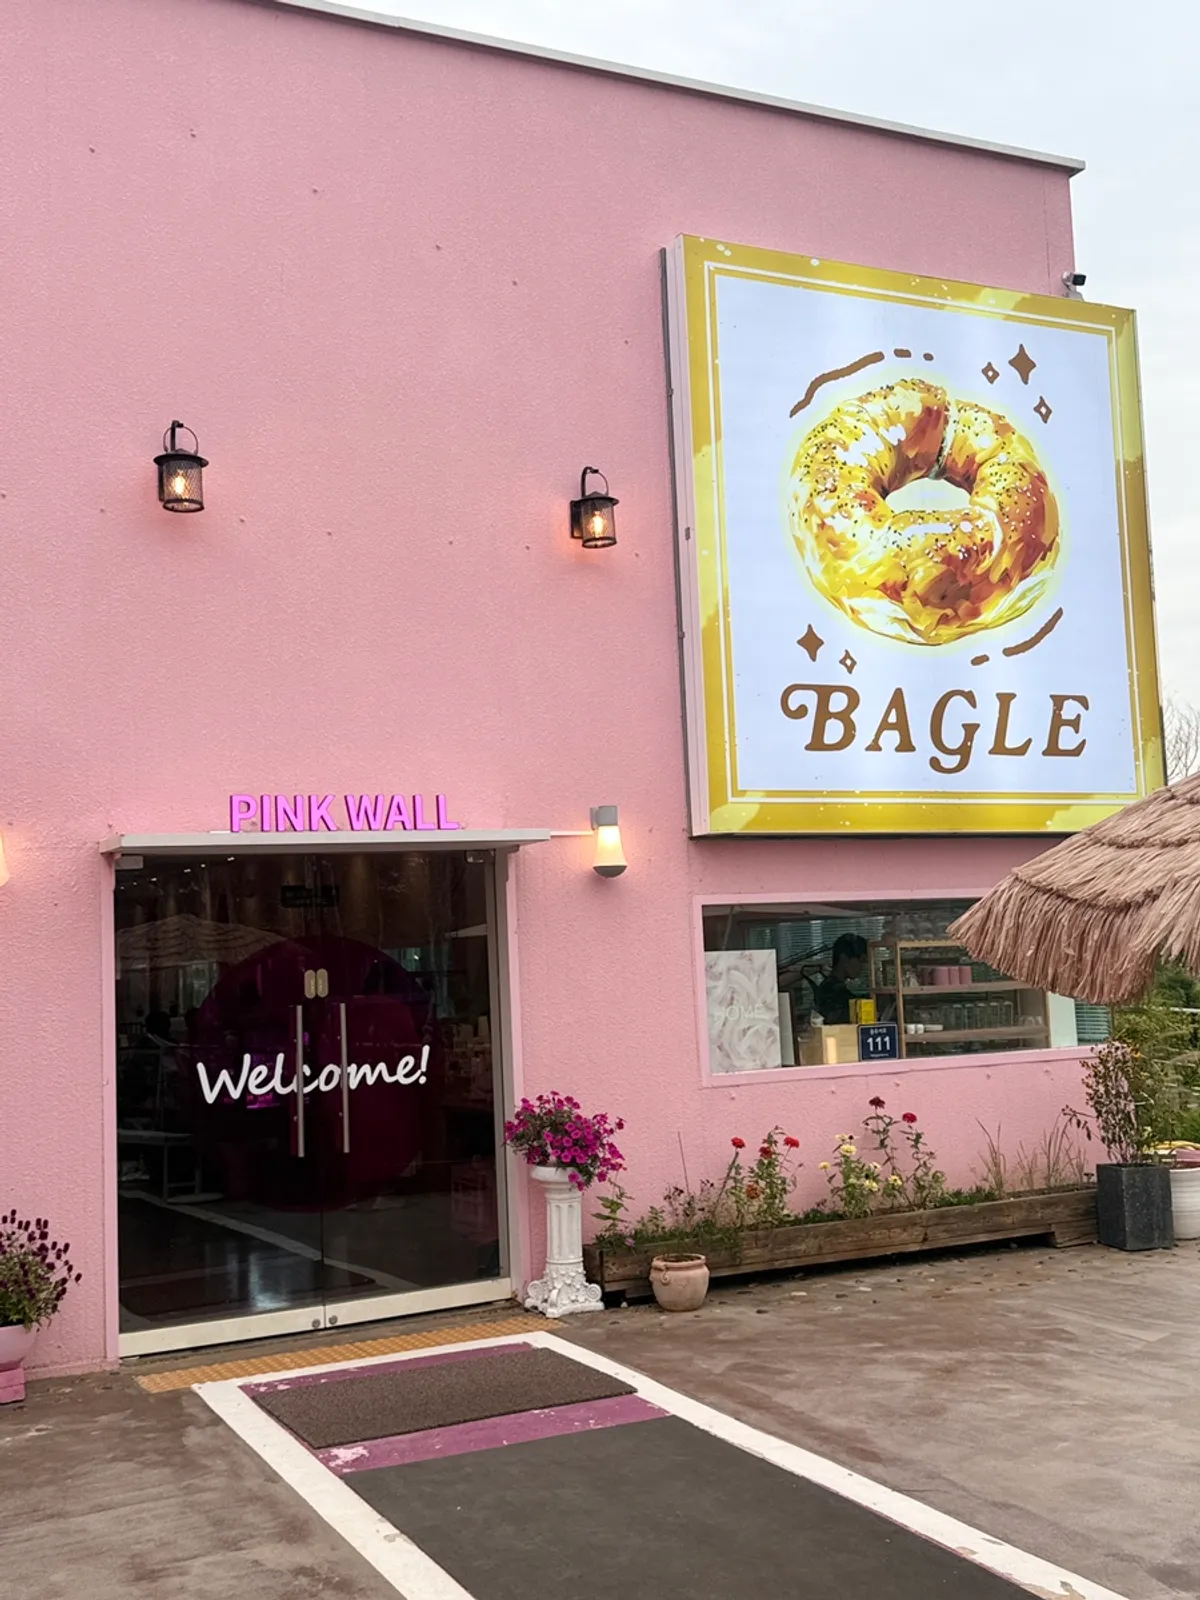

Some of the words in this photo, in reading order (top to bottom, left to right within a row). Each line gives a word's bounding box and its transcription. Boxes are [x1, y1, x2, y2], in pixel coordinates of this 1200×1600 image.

[780, 683, 1090, 774] BAGLE
[230, 794, 337, 832] PINK
[344, 793, 461, 830] WALL
[866, 1036, 891, 1052] 111
[196, 1045, 431, 1104] Welcome!
